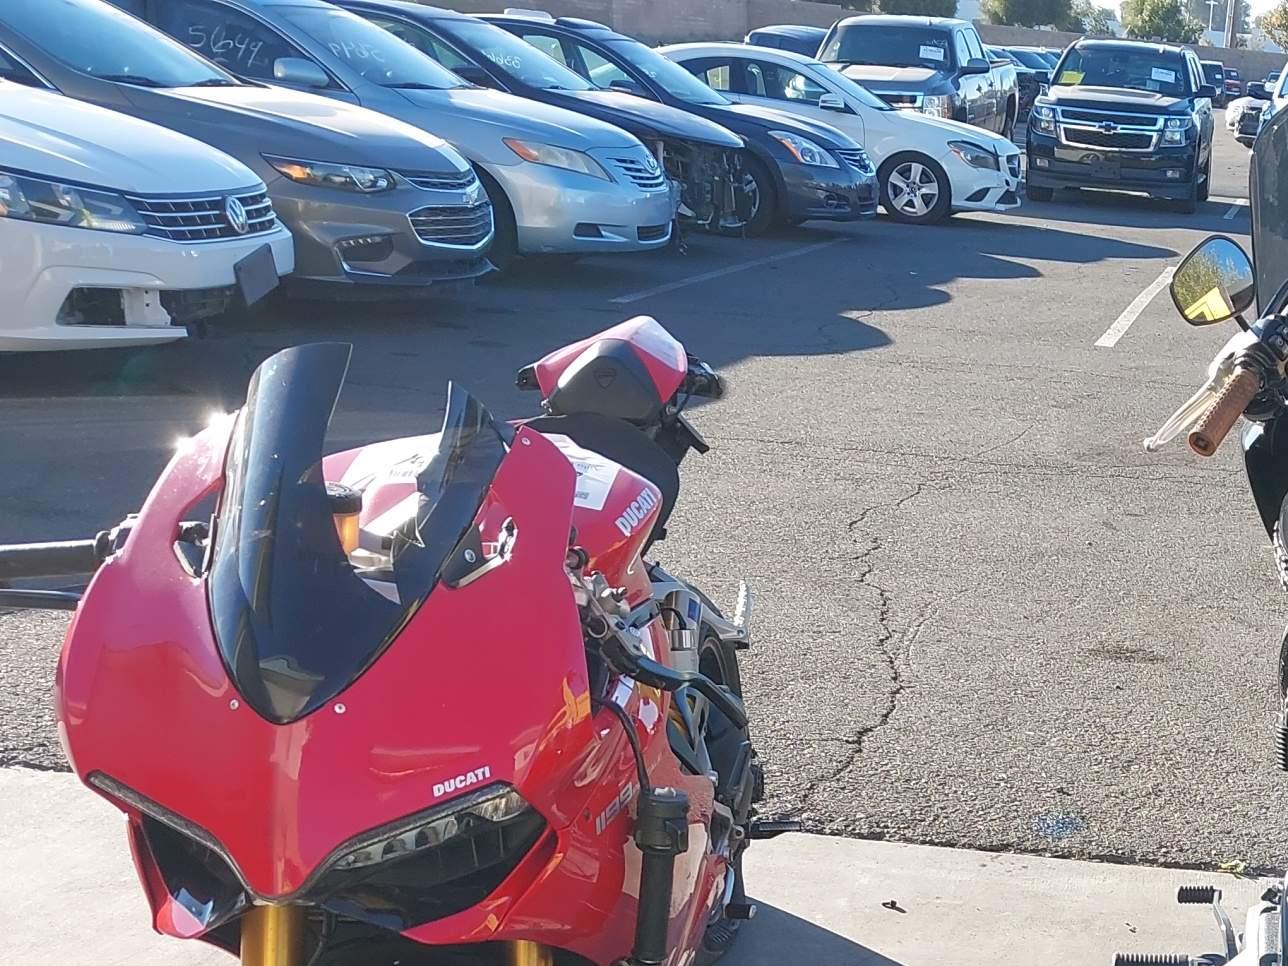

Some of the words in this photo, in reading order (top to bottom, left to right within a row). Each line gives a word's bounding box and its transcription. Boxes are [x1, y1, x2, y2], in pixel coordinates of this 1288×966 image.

[614, 488, 657, 537] DUCATI
[432, 766, 491, 797] DUCATI
[596, 781, 634, 836] 1199
